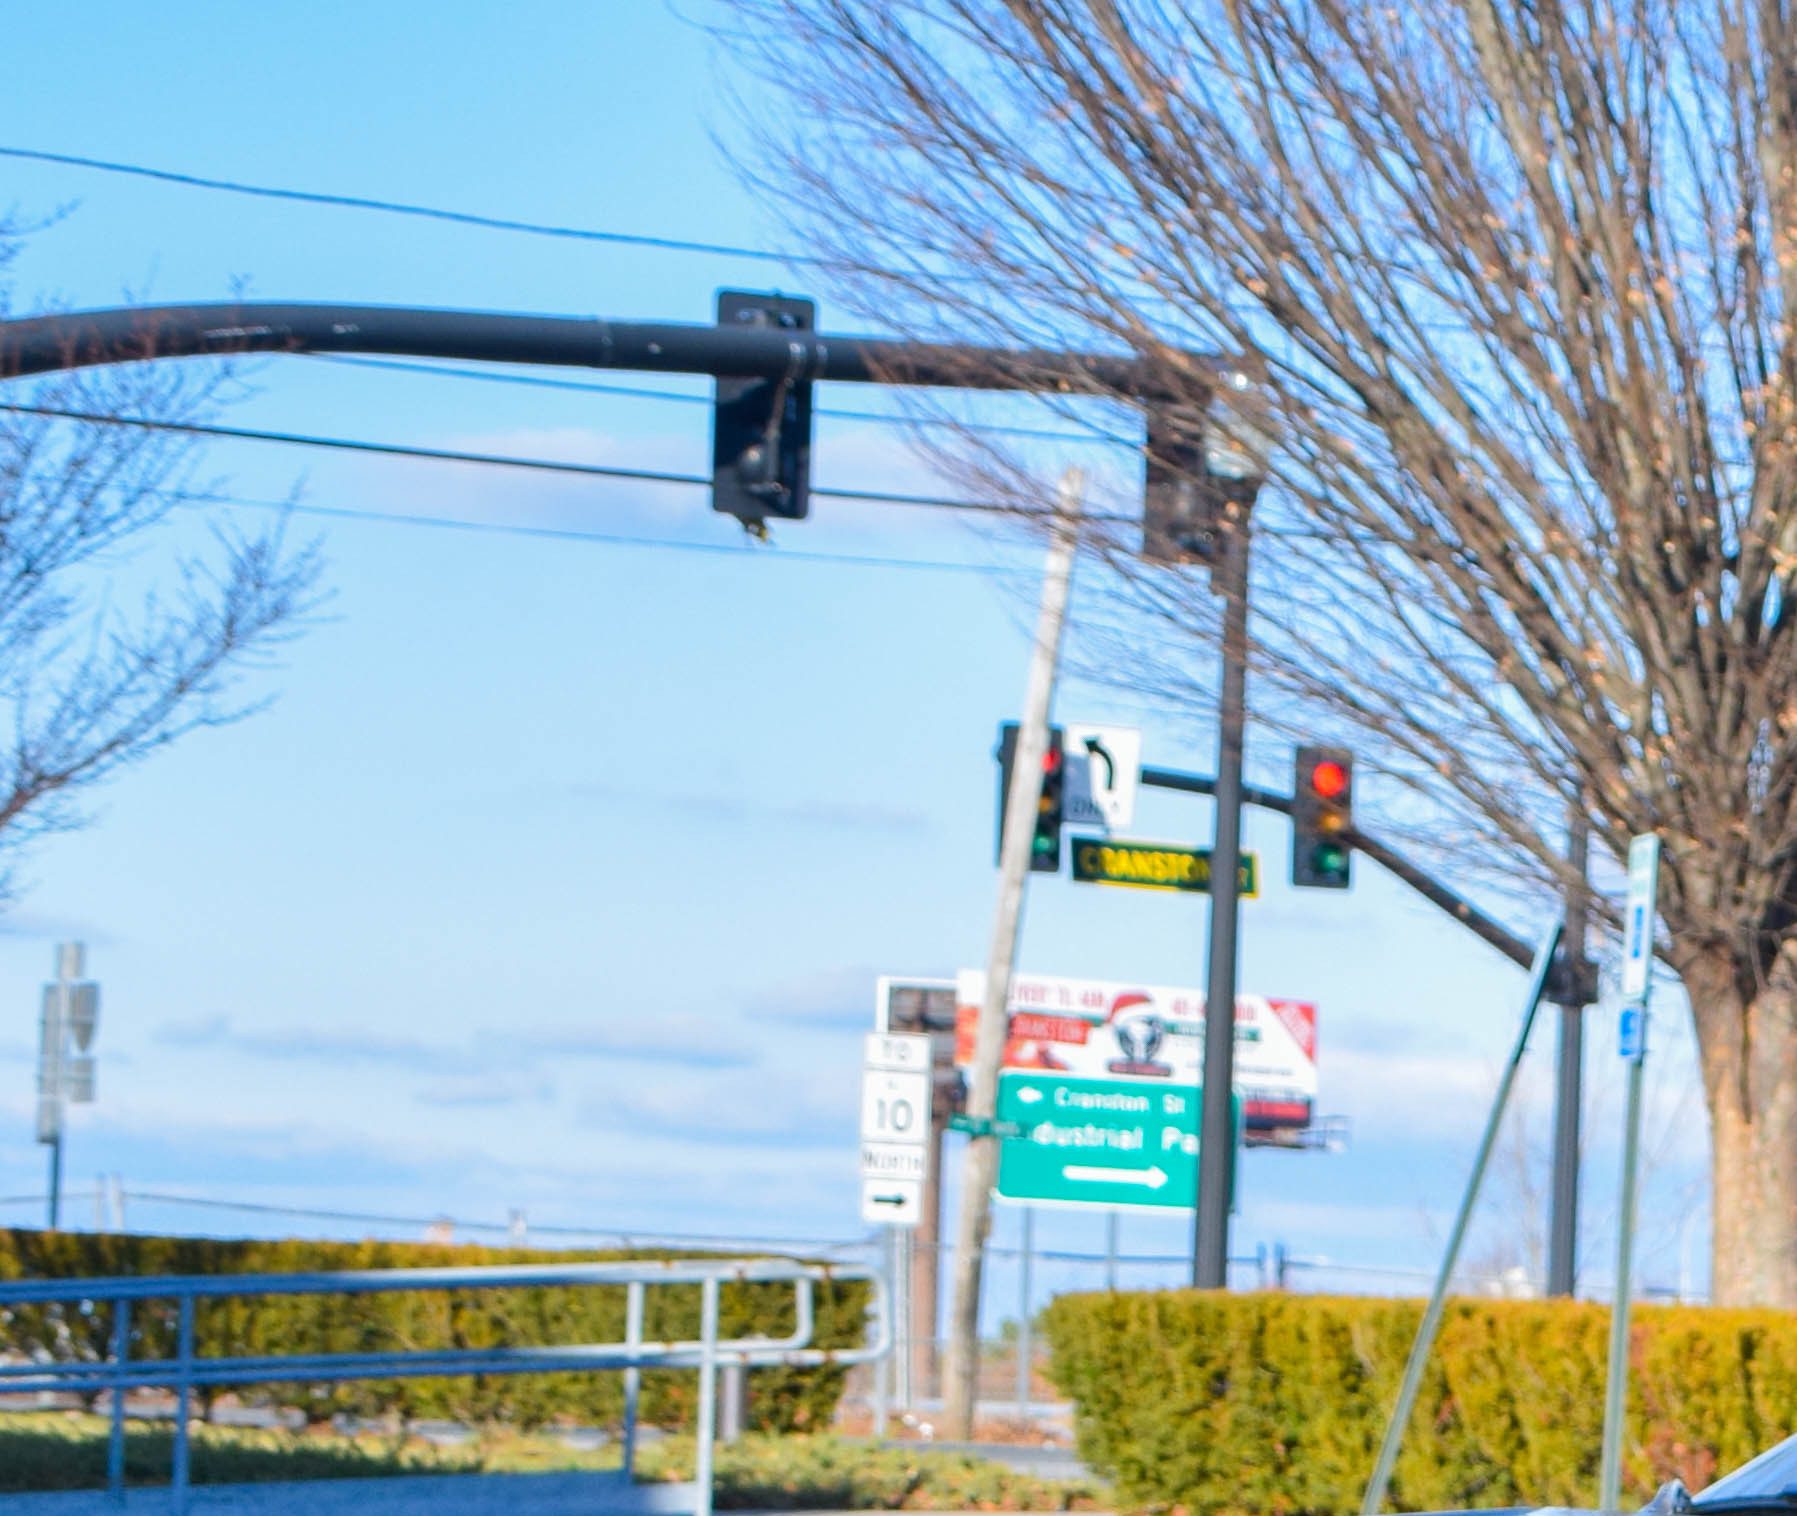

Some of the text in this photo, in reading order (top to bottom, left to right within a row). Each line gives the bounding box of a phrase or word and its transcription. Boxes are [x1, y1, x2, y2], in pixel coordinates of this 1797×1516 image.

[876, 1098, 914, 1133] 10
[1054, 1086, 1150, 1113] Cranston
[1033, 1121, 1143, 1151] dustrial
[1161, 1126, 1200, 1155] Pa
